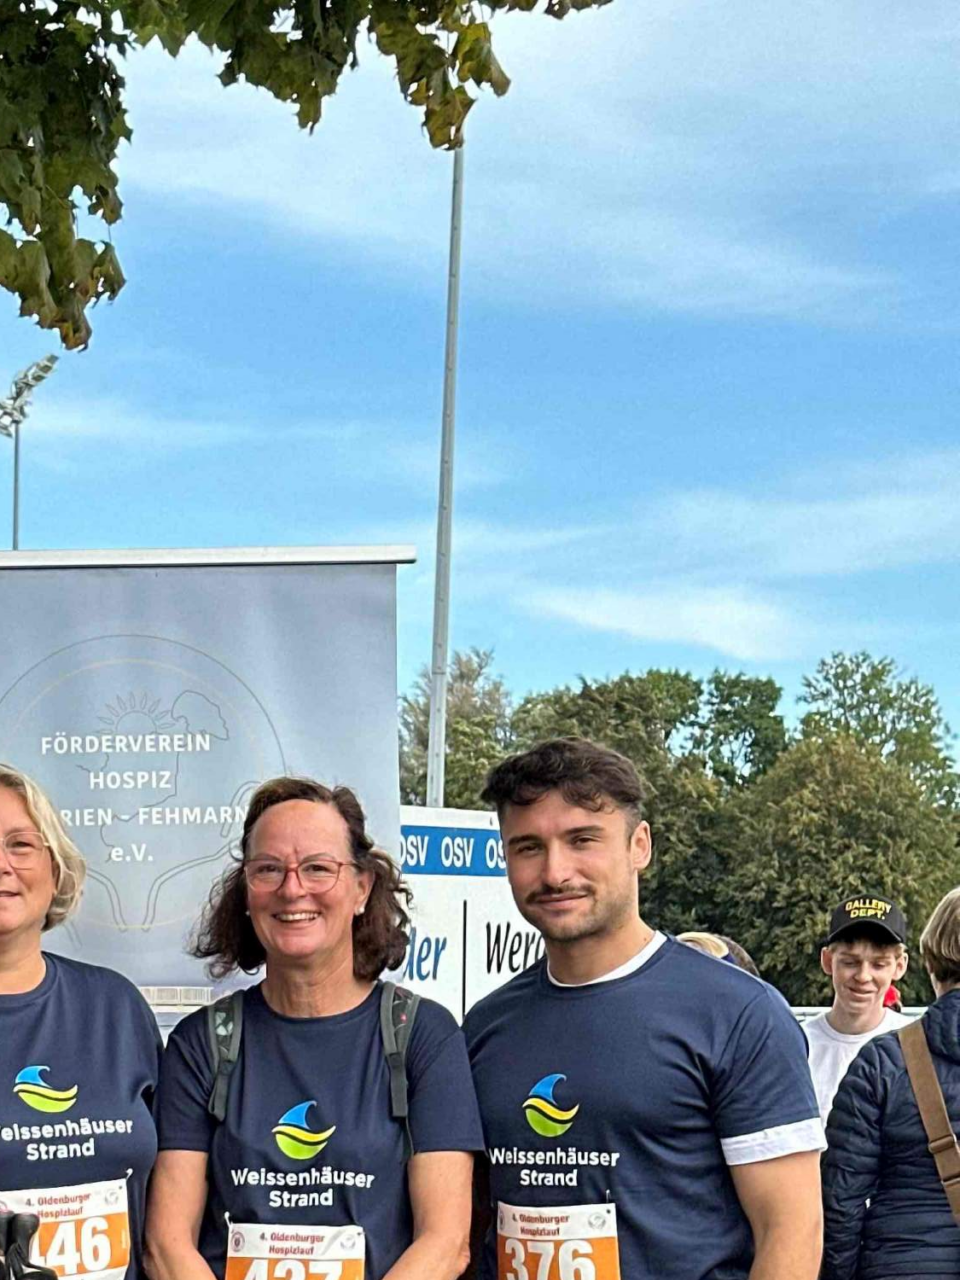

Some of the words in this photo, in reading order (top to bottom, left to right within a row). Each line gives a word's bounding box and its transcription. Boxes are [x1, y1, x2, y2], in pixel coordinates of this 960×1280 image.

[41, 732, 211, 755] FÖRDERVEREIN
[89, 771, 171, 789] HOSPIZ
[60, 808, 112, 827] RIEN
[139, 806, 248, 826] FEHMARN
[111, 844, 154, 862] e.V.
[441, 836, 474, 868] OSV
[486, 840, 506, 869] OS
[26, 1138, 95, 1161] Strand
[489, 1147, 620, 1167] Weissenhäuser
[231, 1166, 375, 1189] Weissenhäuser
[519, 1169, 578, 1187] Strand
[268, 1189, 334, 1208] Strand
[270, 1232, 326, 1244] Oldenburger
